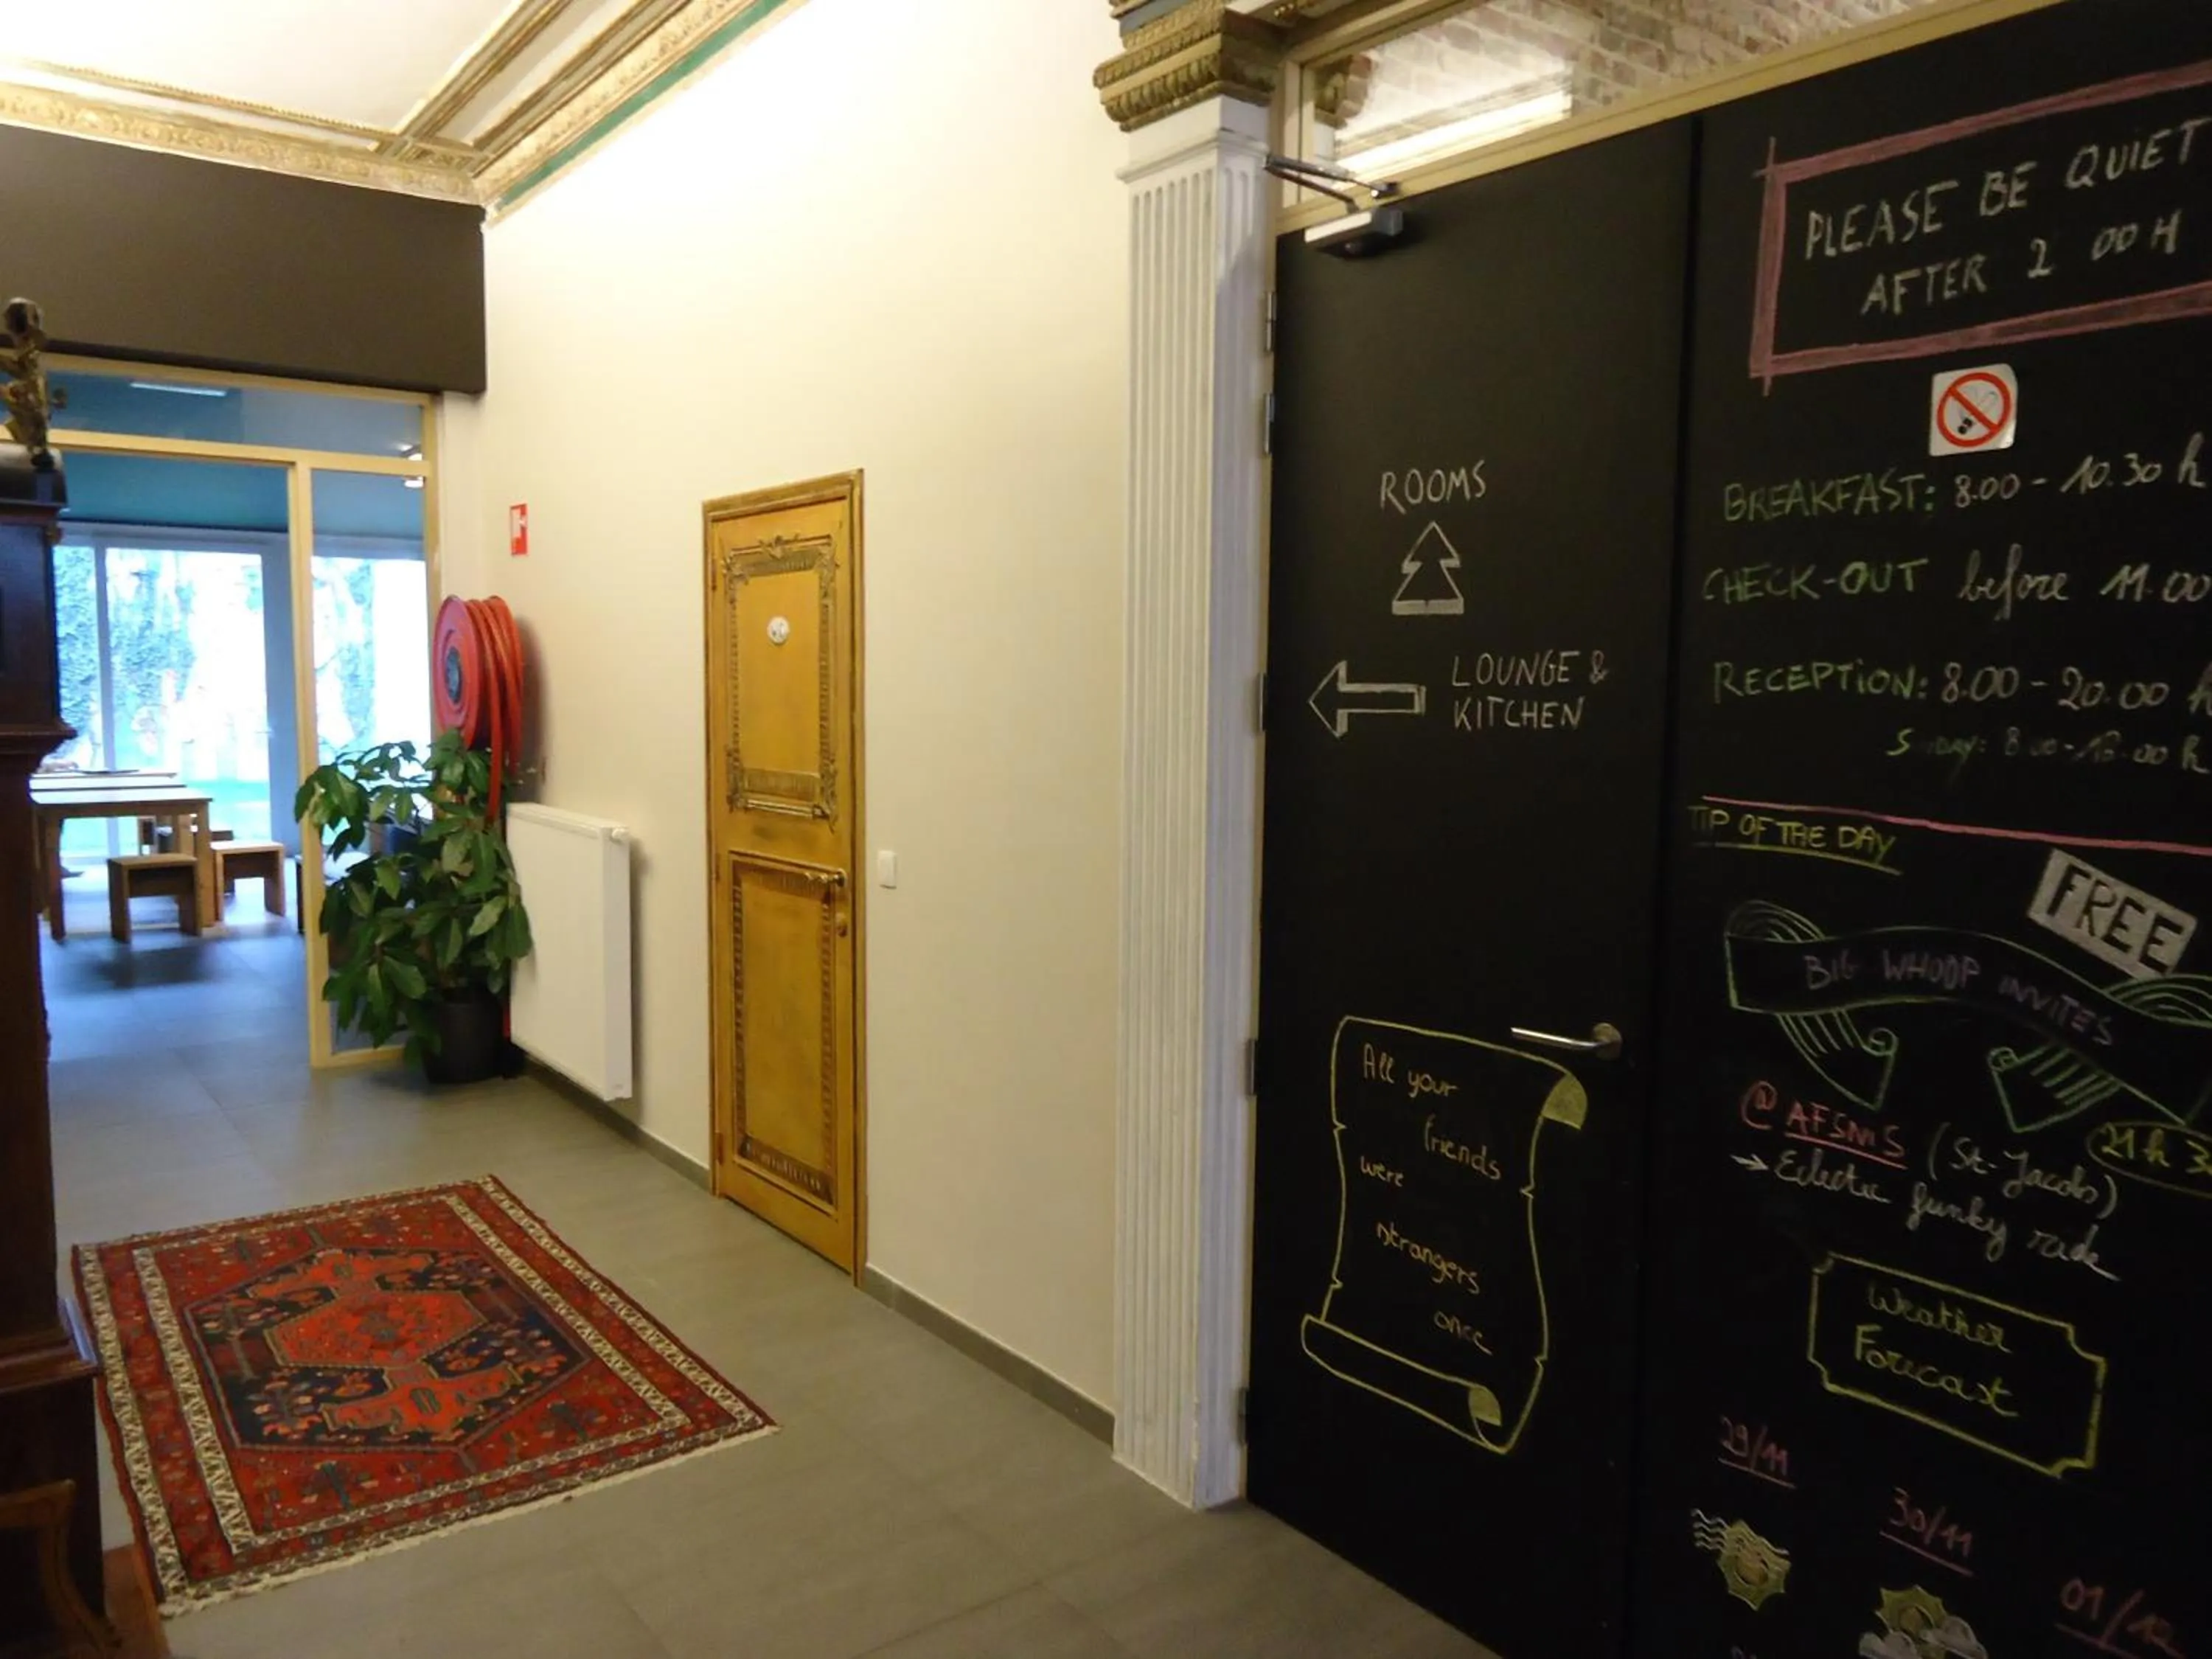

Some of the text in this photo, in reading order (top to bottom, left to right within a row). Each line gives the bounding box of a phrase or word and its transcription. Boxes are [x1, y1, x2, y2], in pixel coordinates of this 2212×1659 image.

[1806, 116, 2212, 260] PLEASE BE QUIET
[1860, 254, 1986, 316] AFTER
[1380, 459, 1486, 514] ROOMS
[1723, 466, 1936, 522] BREAKFAST:
[1703, 557, 1929, 605] CHECK-OUT
[1958, 543, 2069, 621] before
[1452, 650, 1609, 686] LOUNGE &
[1454, 696, 1585, 732] KITCHEN
[1687, 805, 1897, 865] TIP OF THE DAY
[2047, 861, 2184, 973] FREE
[1804, 949, 1859, 990] BIG
[1882, 947, 1981, 990] WHOOP
[1363, 1043, 1459, 1099] All your
[1360, 1155, 1405, 1188] were
[1424, 1113, 1502, 1180] friends
[1905, 1180, 2007, 1263] funky
[1434, 1310, 1494, 1355] once
[1865, 1281, 2013, 1354] Weather
